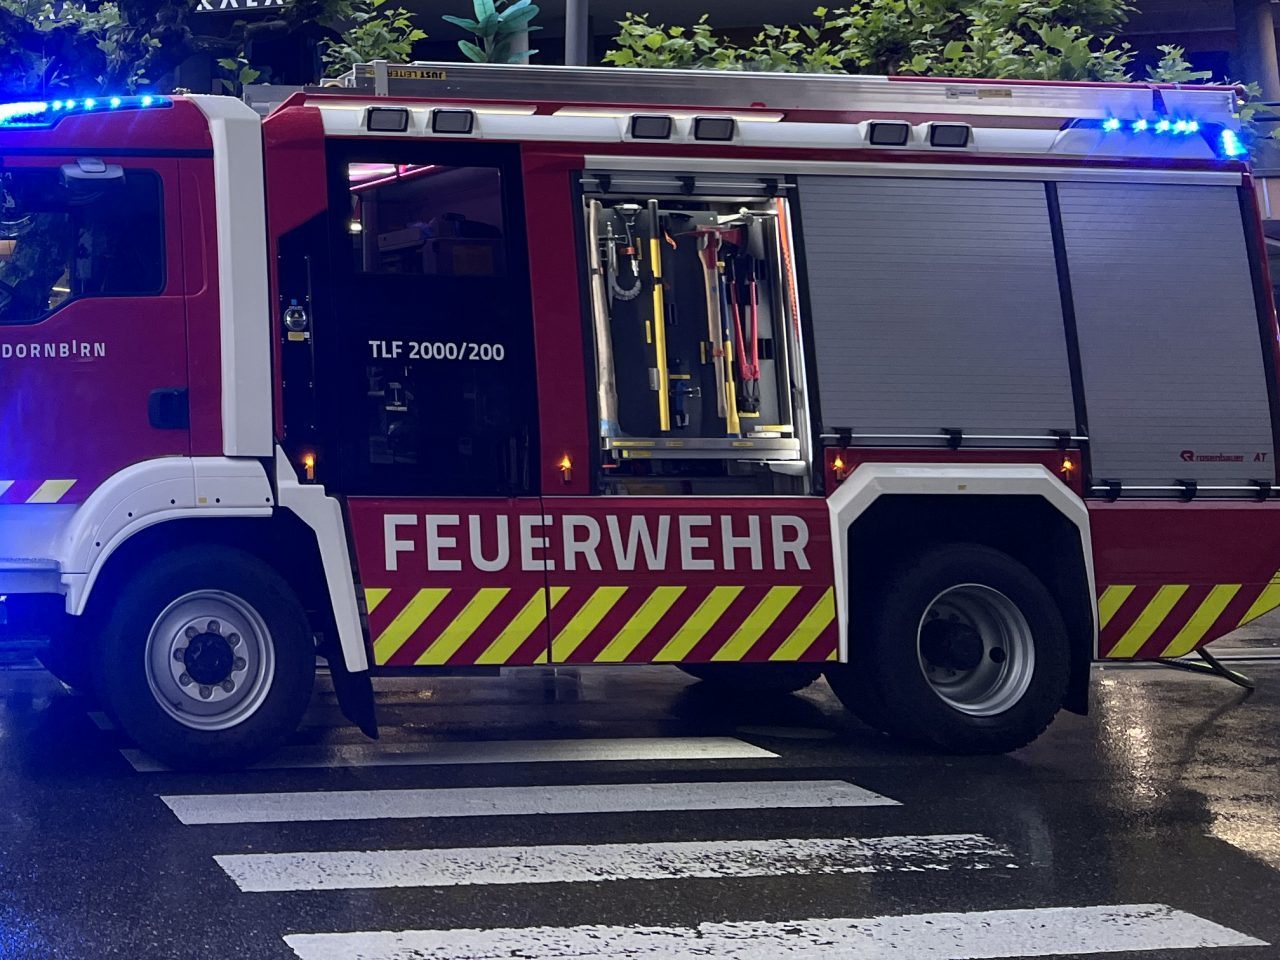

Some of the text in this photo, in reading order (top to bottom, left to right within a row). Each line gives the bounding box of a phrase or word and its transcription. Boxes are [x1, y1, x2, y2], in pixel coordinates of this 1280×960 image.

[1, 339, 106, 358] DORNBIRN
[368, 340, 505, 361] TLF 2000/200
[1253, 452, 1268, 463] AT
[382, 513, 813, 572] FEUERWEHR
